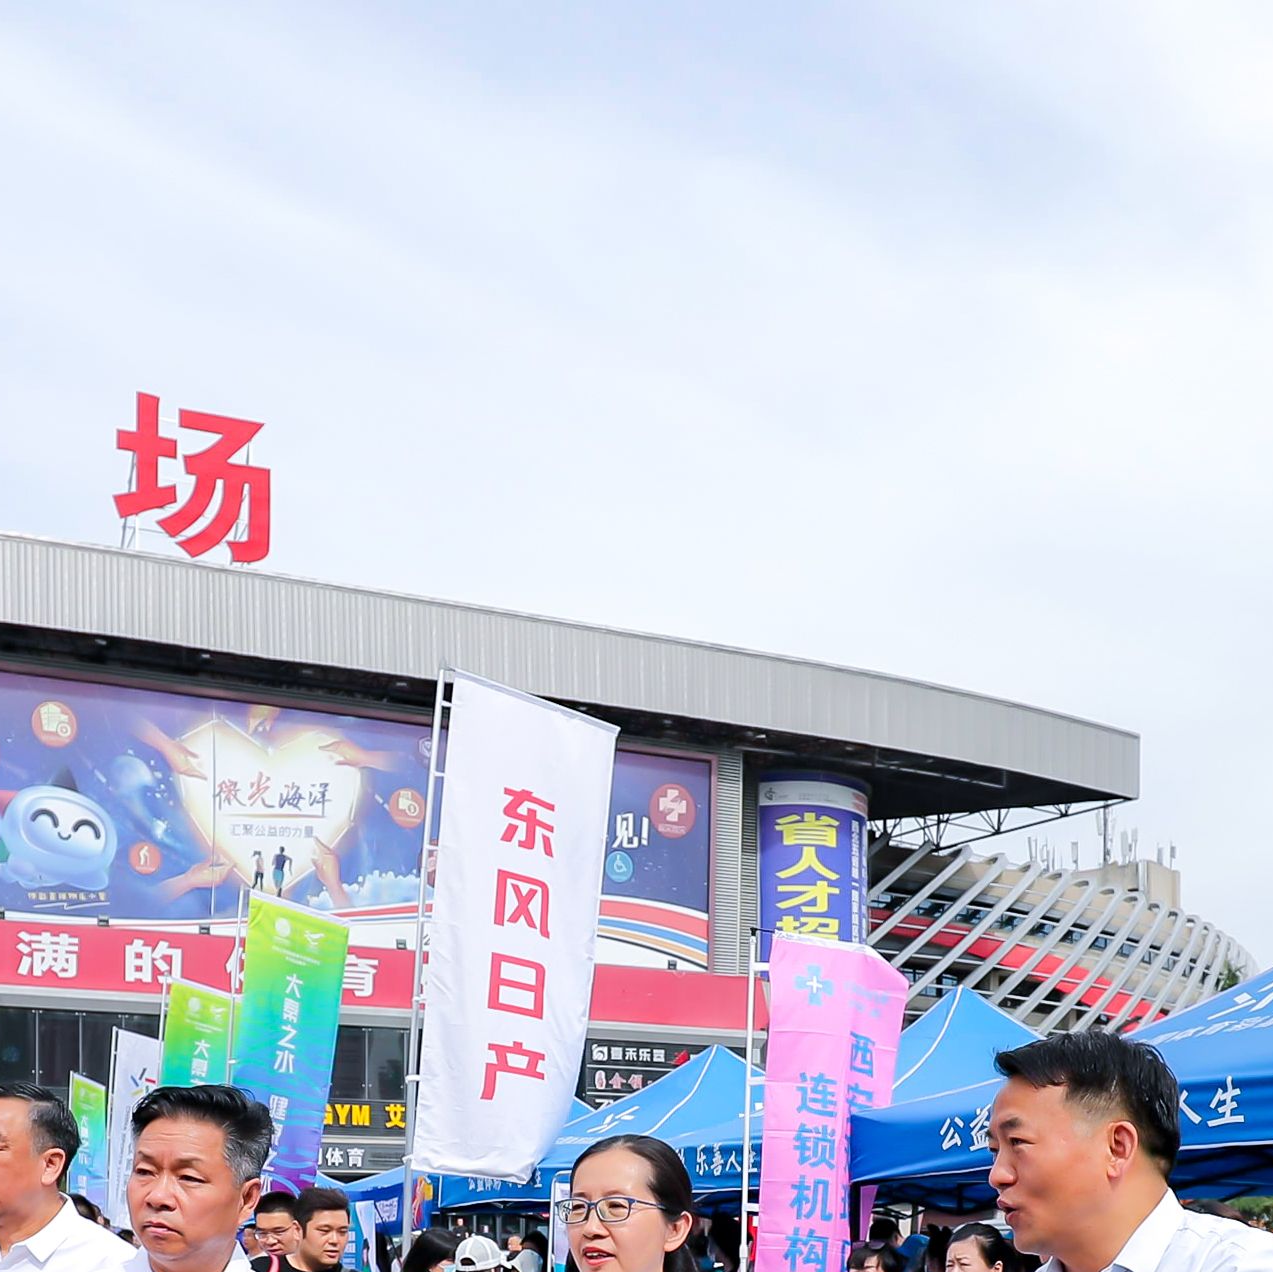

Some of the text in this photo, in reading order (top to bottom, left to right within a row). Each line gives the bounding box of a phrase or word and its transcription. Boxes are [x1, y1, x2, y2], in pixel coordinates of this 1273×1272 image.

[231, 823, 315, 839] 汇聚公益的力量
[480, 786, 556, 1102] 东风日产
